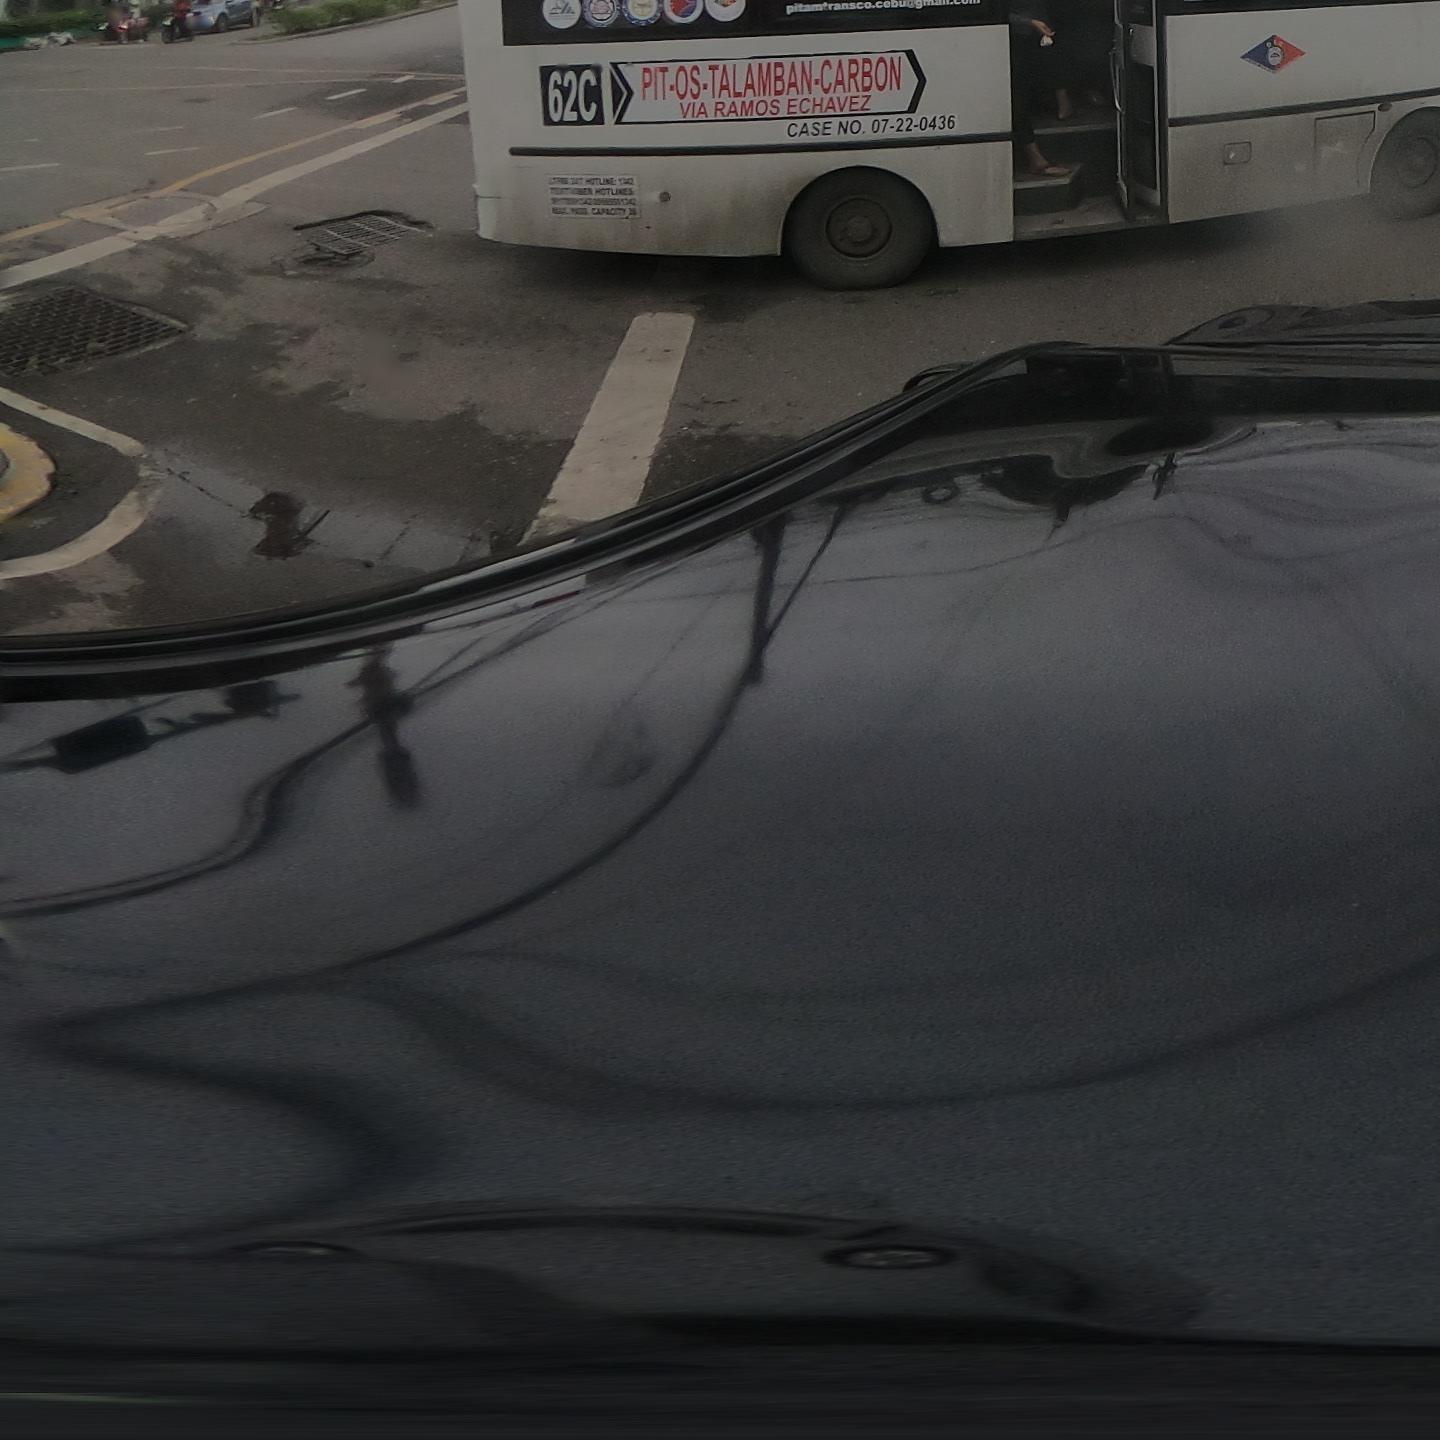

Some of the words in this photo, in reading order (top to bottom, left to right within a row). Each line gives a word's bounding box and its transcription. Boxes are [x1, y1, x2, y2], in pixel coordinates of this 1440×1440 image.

[641, 56, 902, 101] PIT-OS-TALAMBAN-CARBON
[548, 69, 597, 123] 62C
[679, 101, 709, 118] VIA
[714, 99, 781, 118] RAMOS
[786, 94, 872, 115] ECHAVEZ
[787, 120, 832, 138] CASE
[837, 119, 866, 136] NO.
[871, 115, 956, 135] 07-22-0436
